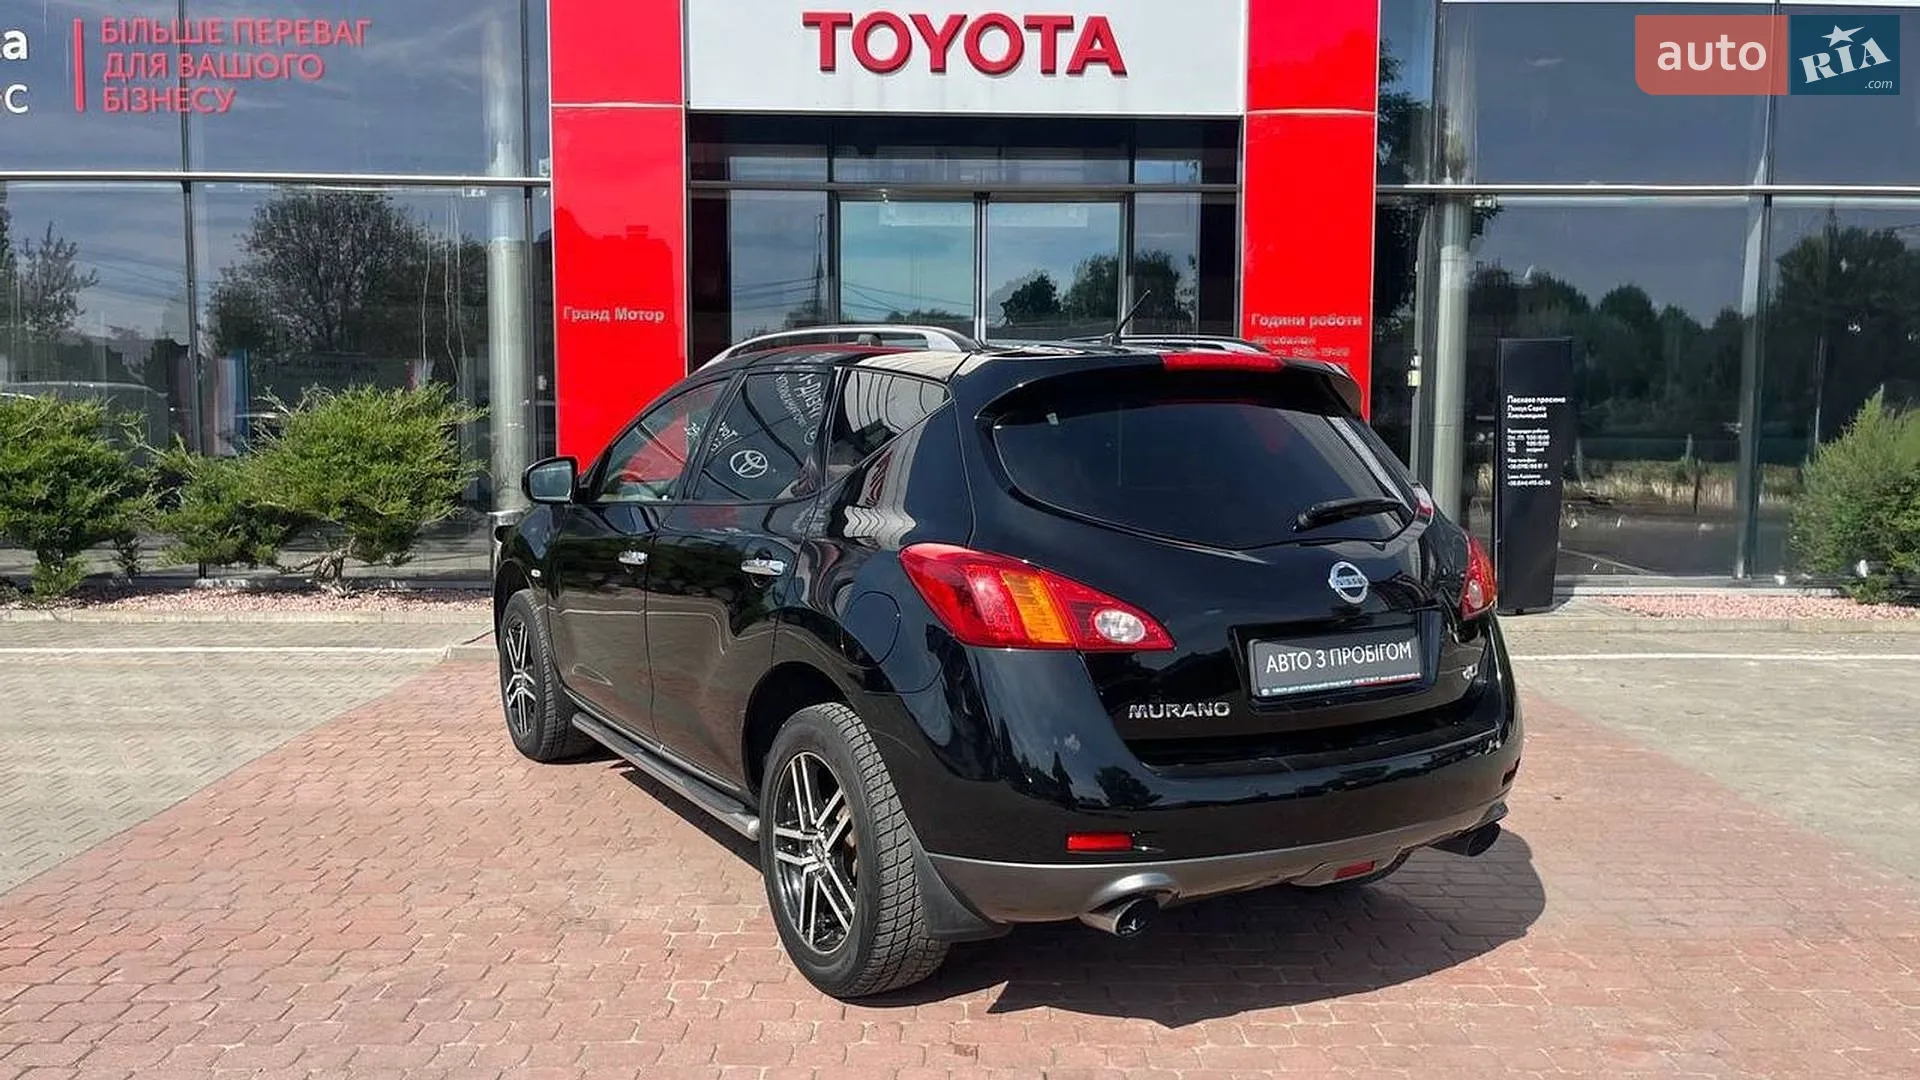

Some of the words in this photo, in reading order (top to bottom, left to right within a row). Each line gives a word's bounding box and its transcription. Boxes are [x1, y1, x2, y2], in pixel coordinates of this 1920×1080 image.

[101, 17, 223, 45] БІЛЬШЕ
[232, 18, 371, 46] ПЕРЕВАГ
[802, 11, 1128, 76] TOYOTA
[103, 52, 168, 81] ДЛЯ
[177, 53, 326, 82] ВАШОГО
[102, 86, 237, 115] БІЗНЕСУ
[563, 306, 610, 322] Гранд
[614, 307, 665, 322] Мотор
[1251, 313, 1305, 328] Години
[1309, 314, 1362, 329] роботи
[1265, 651, 1312, 675] АВТО
[1330, 641, 1412, 667] ПРОБІГОМ
[1128, 702, 1231, 719] MURANO
